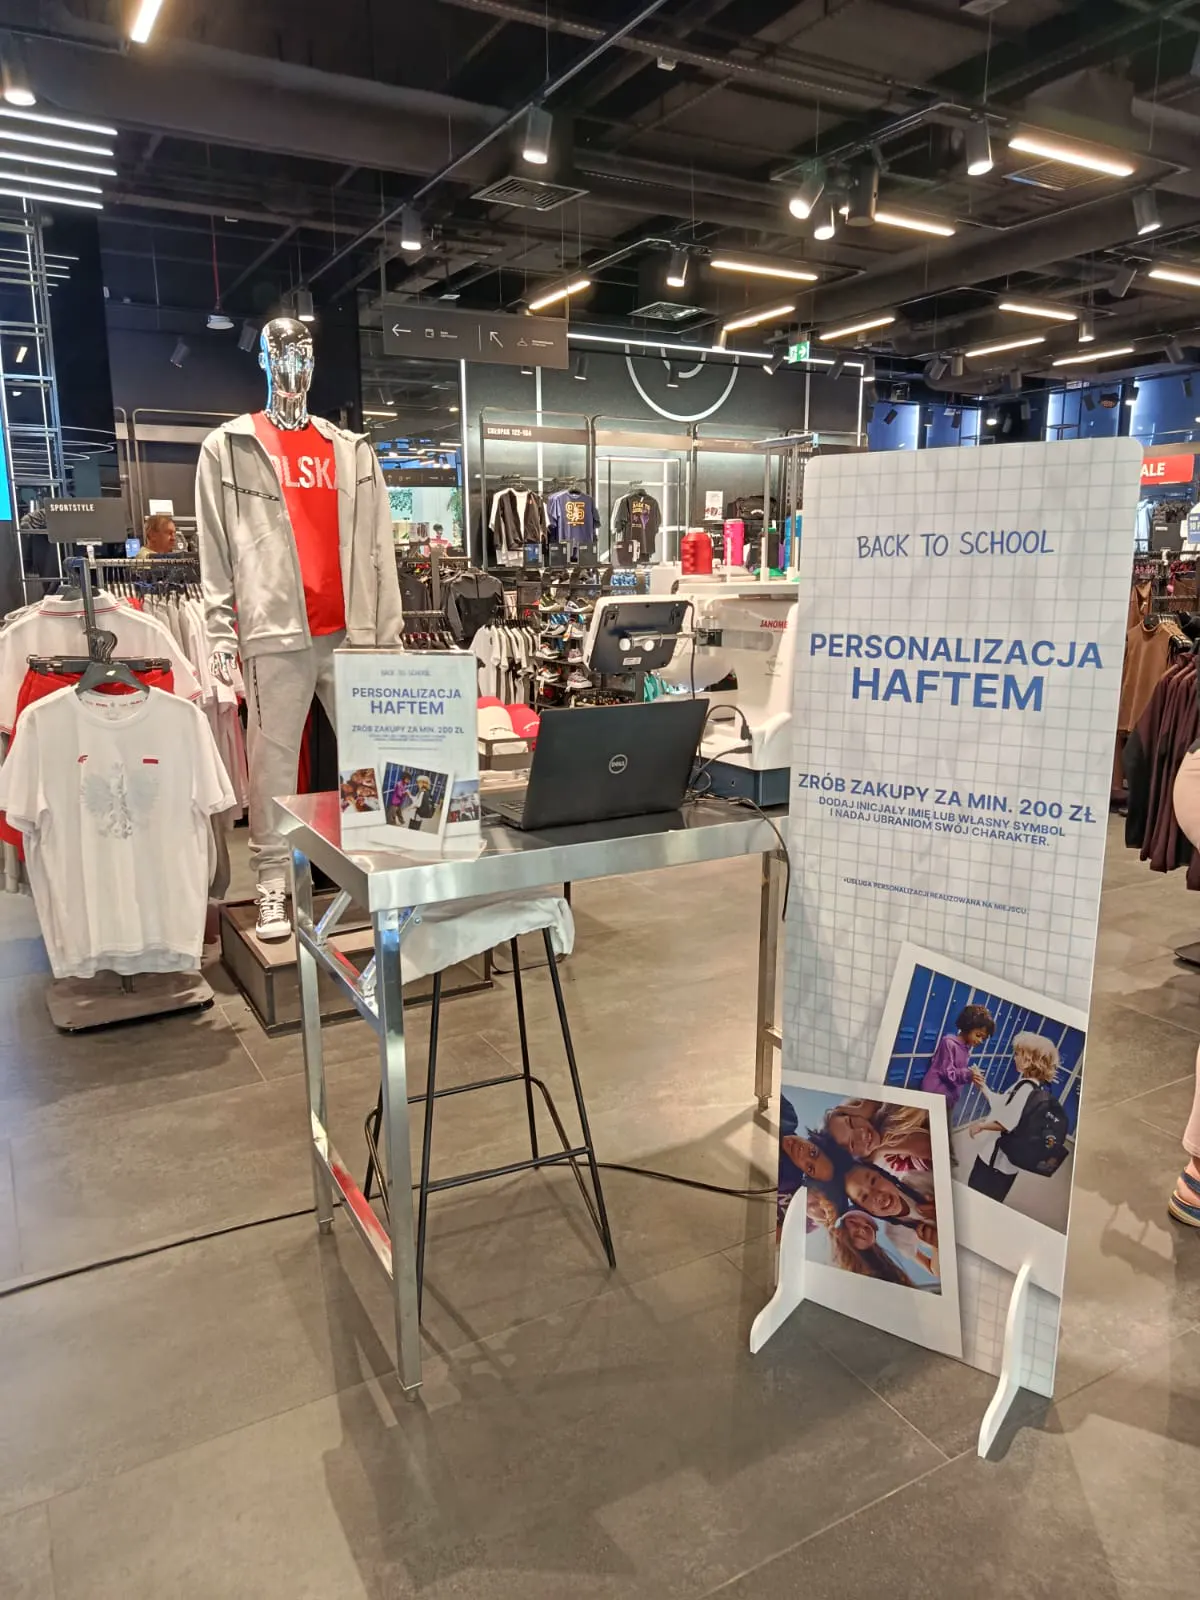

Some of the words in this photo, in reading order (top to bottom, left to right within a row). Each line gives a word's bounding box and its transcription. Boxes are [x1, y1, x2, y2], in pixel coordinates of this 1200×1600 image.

[50, 503, 95, 512] SPORTSTYLE
[857, 534, 909, 558] BACK
[920, 533, 949, 557] TO
[959, 529, 1054, 555] SCHOOL
[810, 633, 1104, 669] PERSONALIZACJA
[352, 687, 462, 699] PERSONALIZACJA
[852, 666, 1045, 712] HAFTEM
[371, 700, 444, 715] HAFTEM
[374, 725, 406, 733] ZAKUPY
[407, 726, 418, 734] ZA
[798, 772, 846, 793] ZRÓB
[850, 779, 929, 802] ZAKUPY
[934, 789, 962, 807] ZA
[967, 792, 1013, 813] MIN.
[1019, 799, 1063, 819] 200
[1069, 804, 1097, 824] ZŁ
[819, 796, 855, 809] DODAJ
[856, 801, 906, 815] INICJAŁY
[908, 807, 931, 821] IMIĘ
[933, 811, 955, 823] LUB
[958, 813, 1011, 829] WŁASNY
[1013, 821, 1066, 837] SYMBOL
[835, 809, 871, 821] NADAJ
[873, 815, 932, 830] UBRANIOM
[934, 822, 969, 835] SWÓJ
[972, 827, 1050, 846] CHARAKTER.
[982, 900, 993, 909] NA
